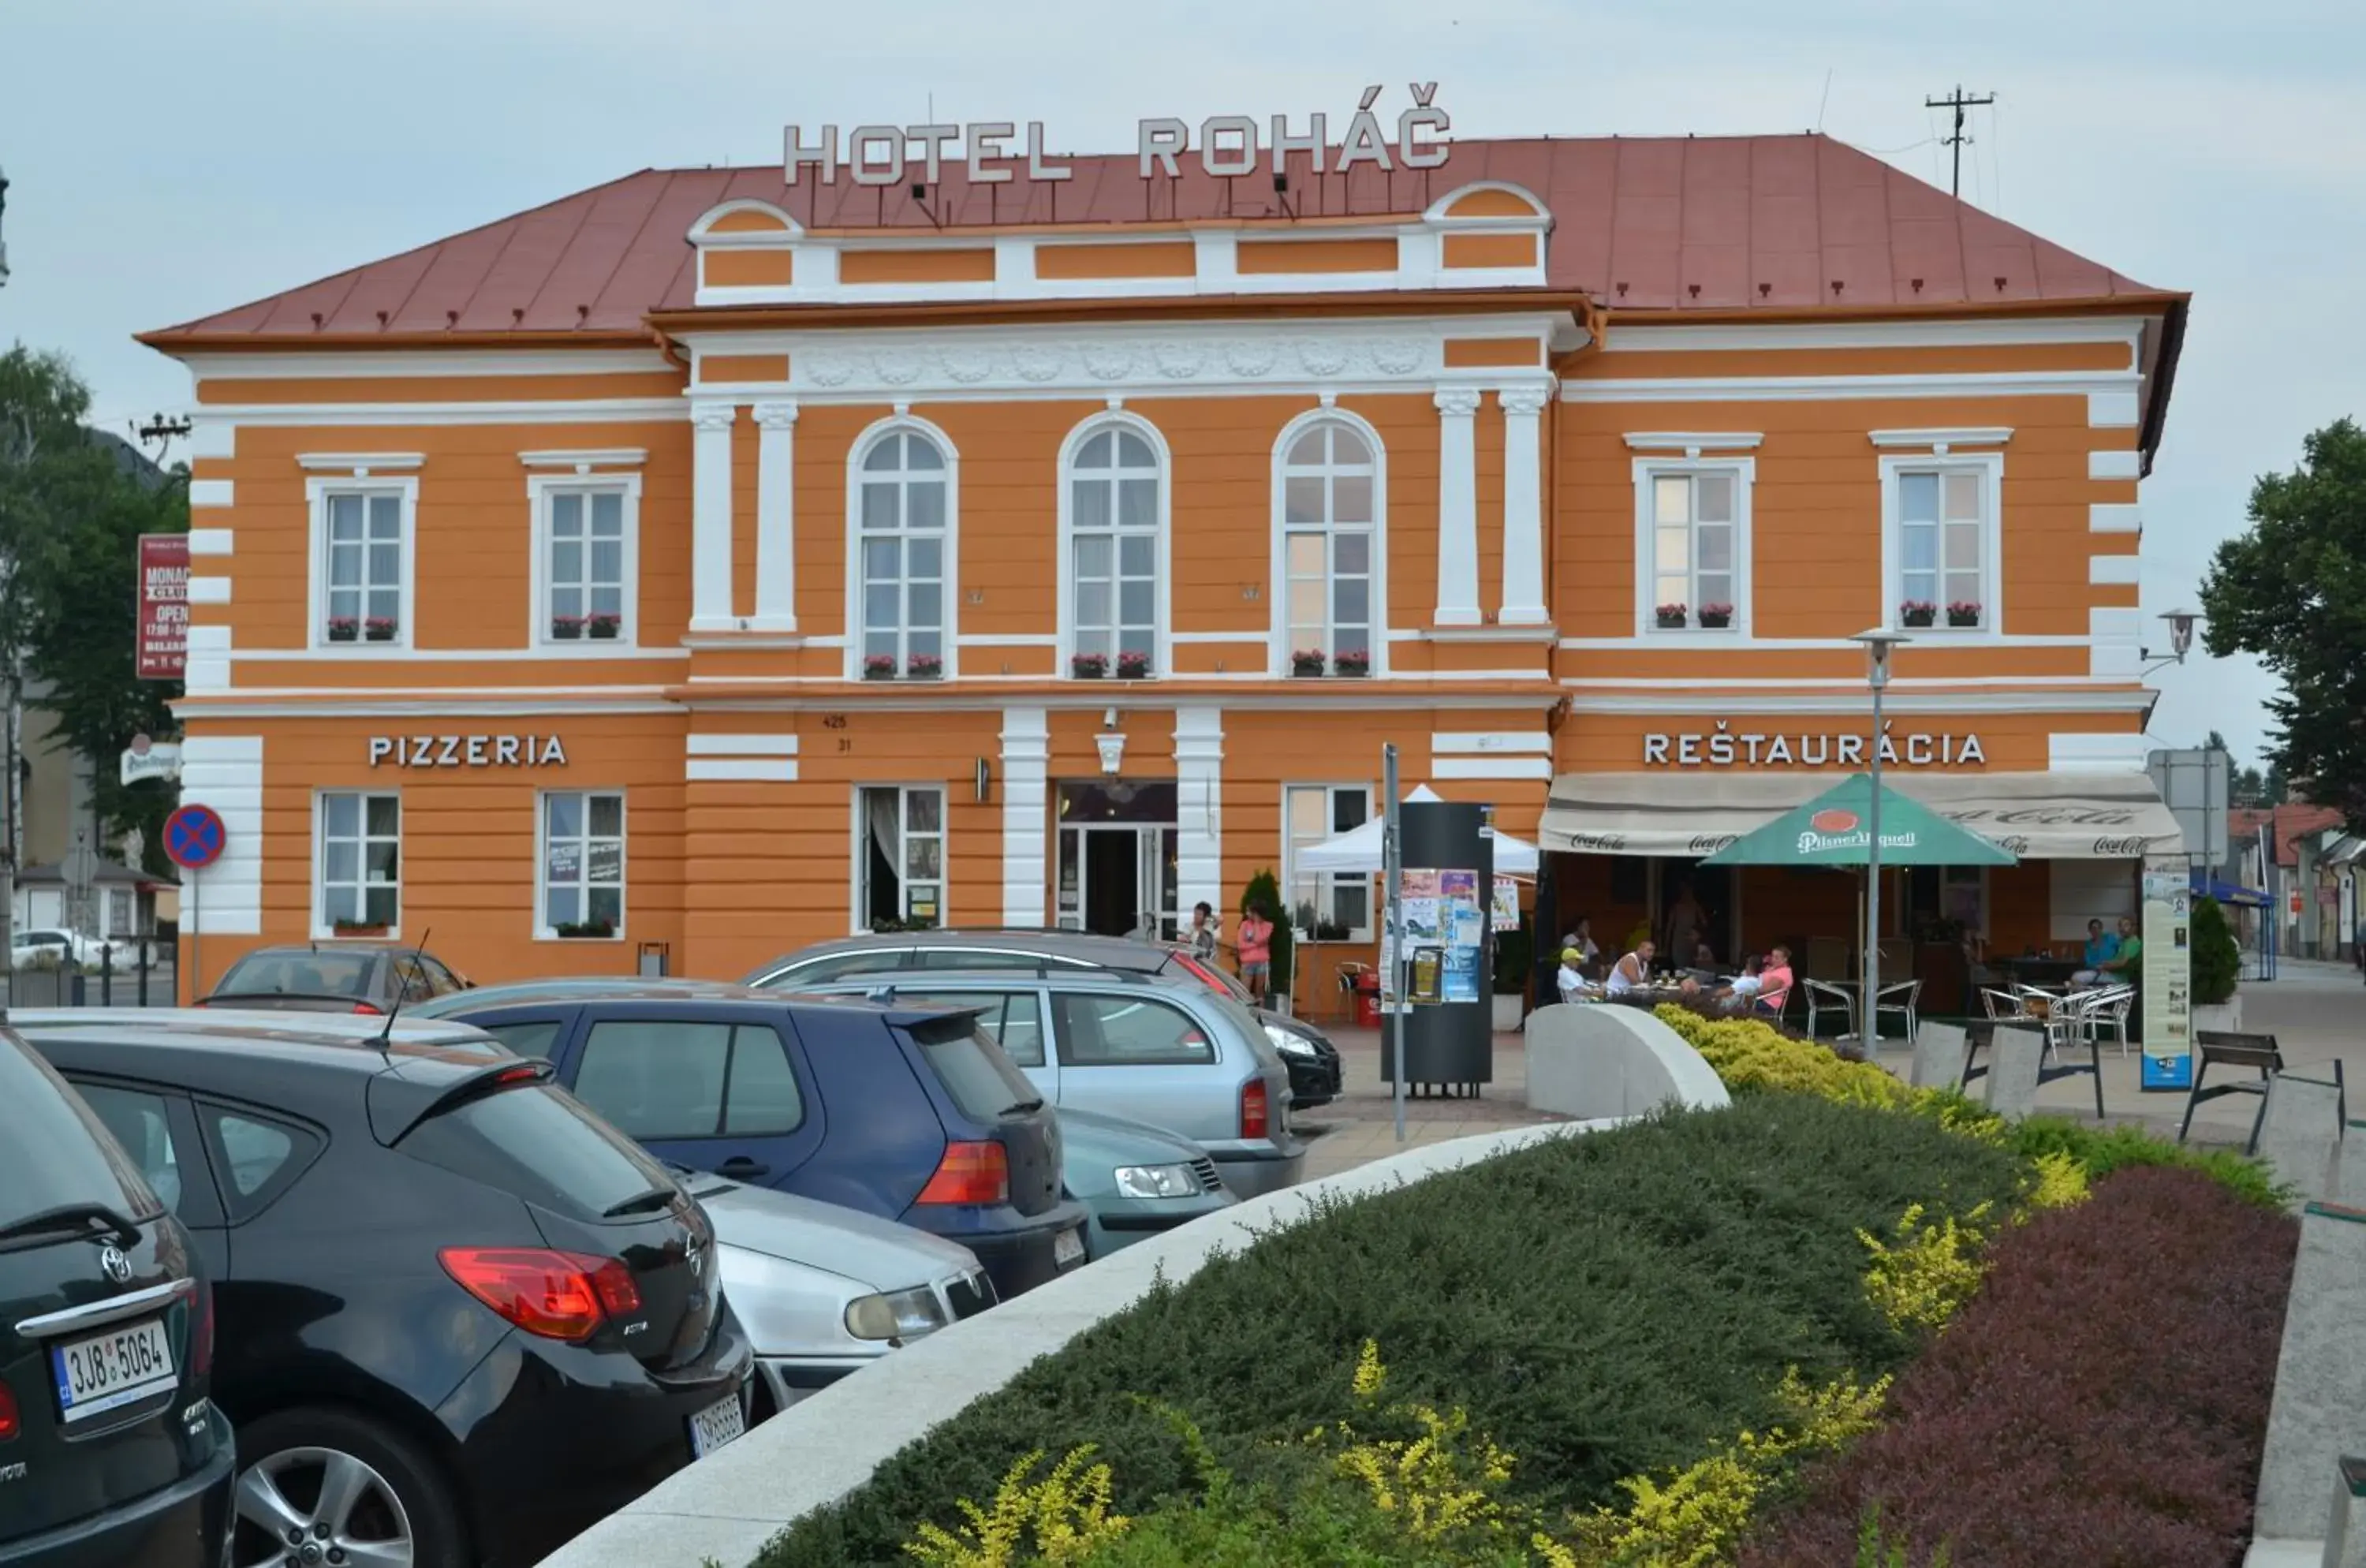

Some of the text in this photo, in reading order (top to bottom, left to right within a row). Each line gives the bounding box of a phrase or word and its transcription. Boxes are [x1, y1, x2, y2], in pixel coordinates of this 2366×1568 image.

[783, 81, 1451, 187] HOTEL ROHÁČ
[146, 566, 191, 584] MONAC
[156, 605, 188, 623] OPEN
[369, 735, 567, 767] PIZZERIA
[1643, 719, 1987, 765] REŠTAURÁCIA
[1797, 831, 1916, 854] Pilsner Uquell
[70, 1329, 163, 1394] 3J8 5064
